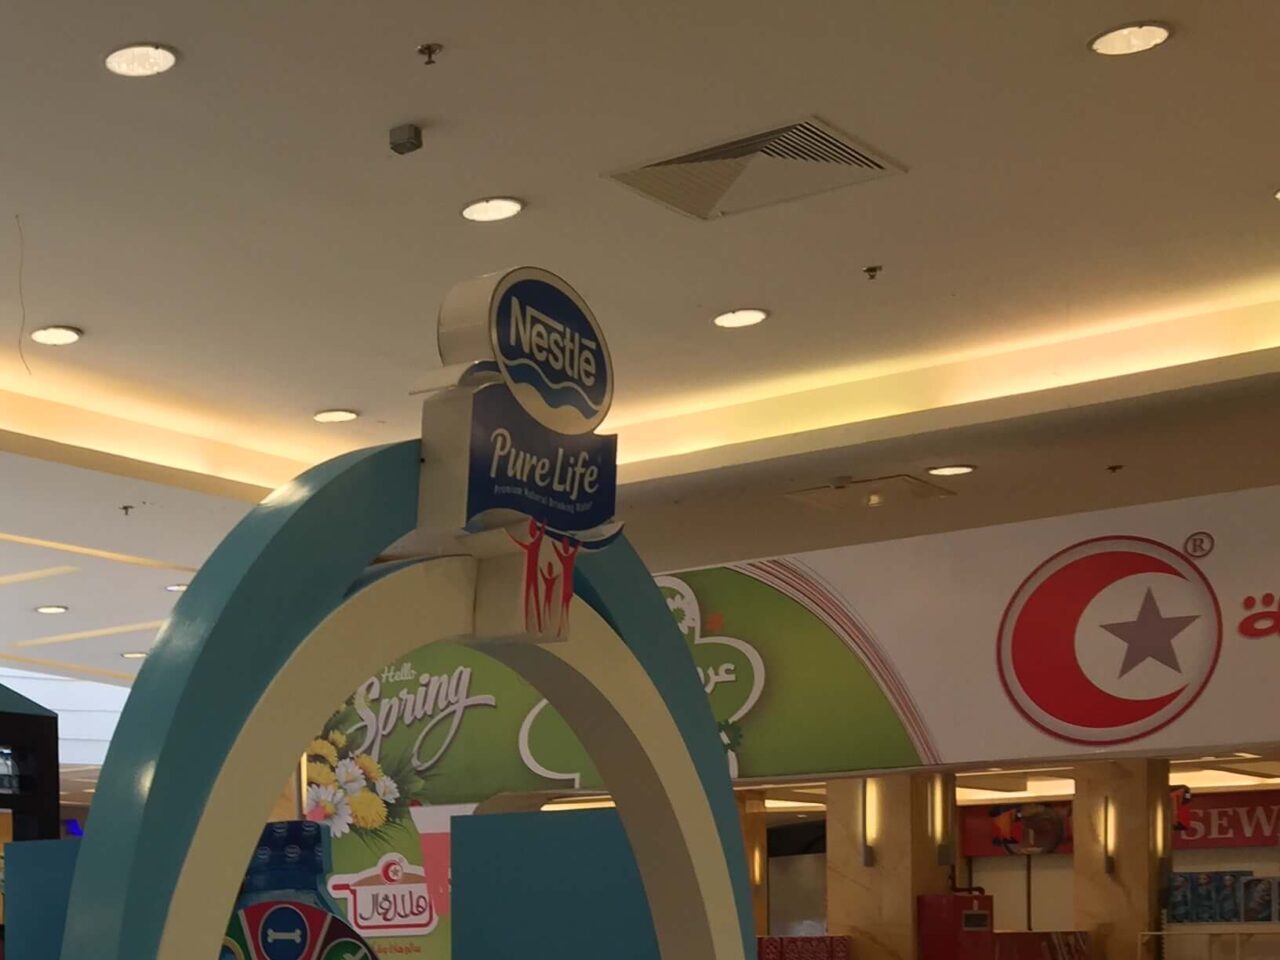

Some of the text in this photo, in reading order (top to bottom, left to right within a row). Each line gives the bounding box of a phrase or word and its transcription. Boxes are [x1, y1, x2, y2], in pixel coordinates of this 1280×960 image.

[509, 295, 597, 387] Nestlé
[489, 427, 599, 501] Pure Life
[345, 665, 496, 771] Spring
[1181, 804, 1280, 841] SEW
